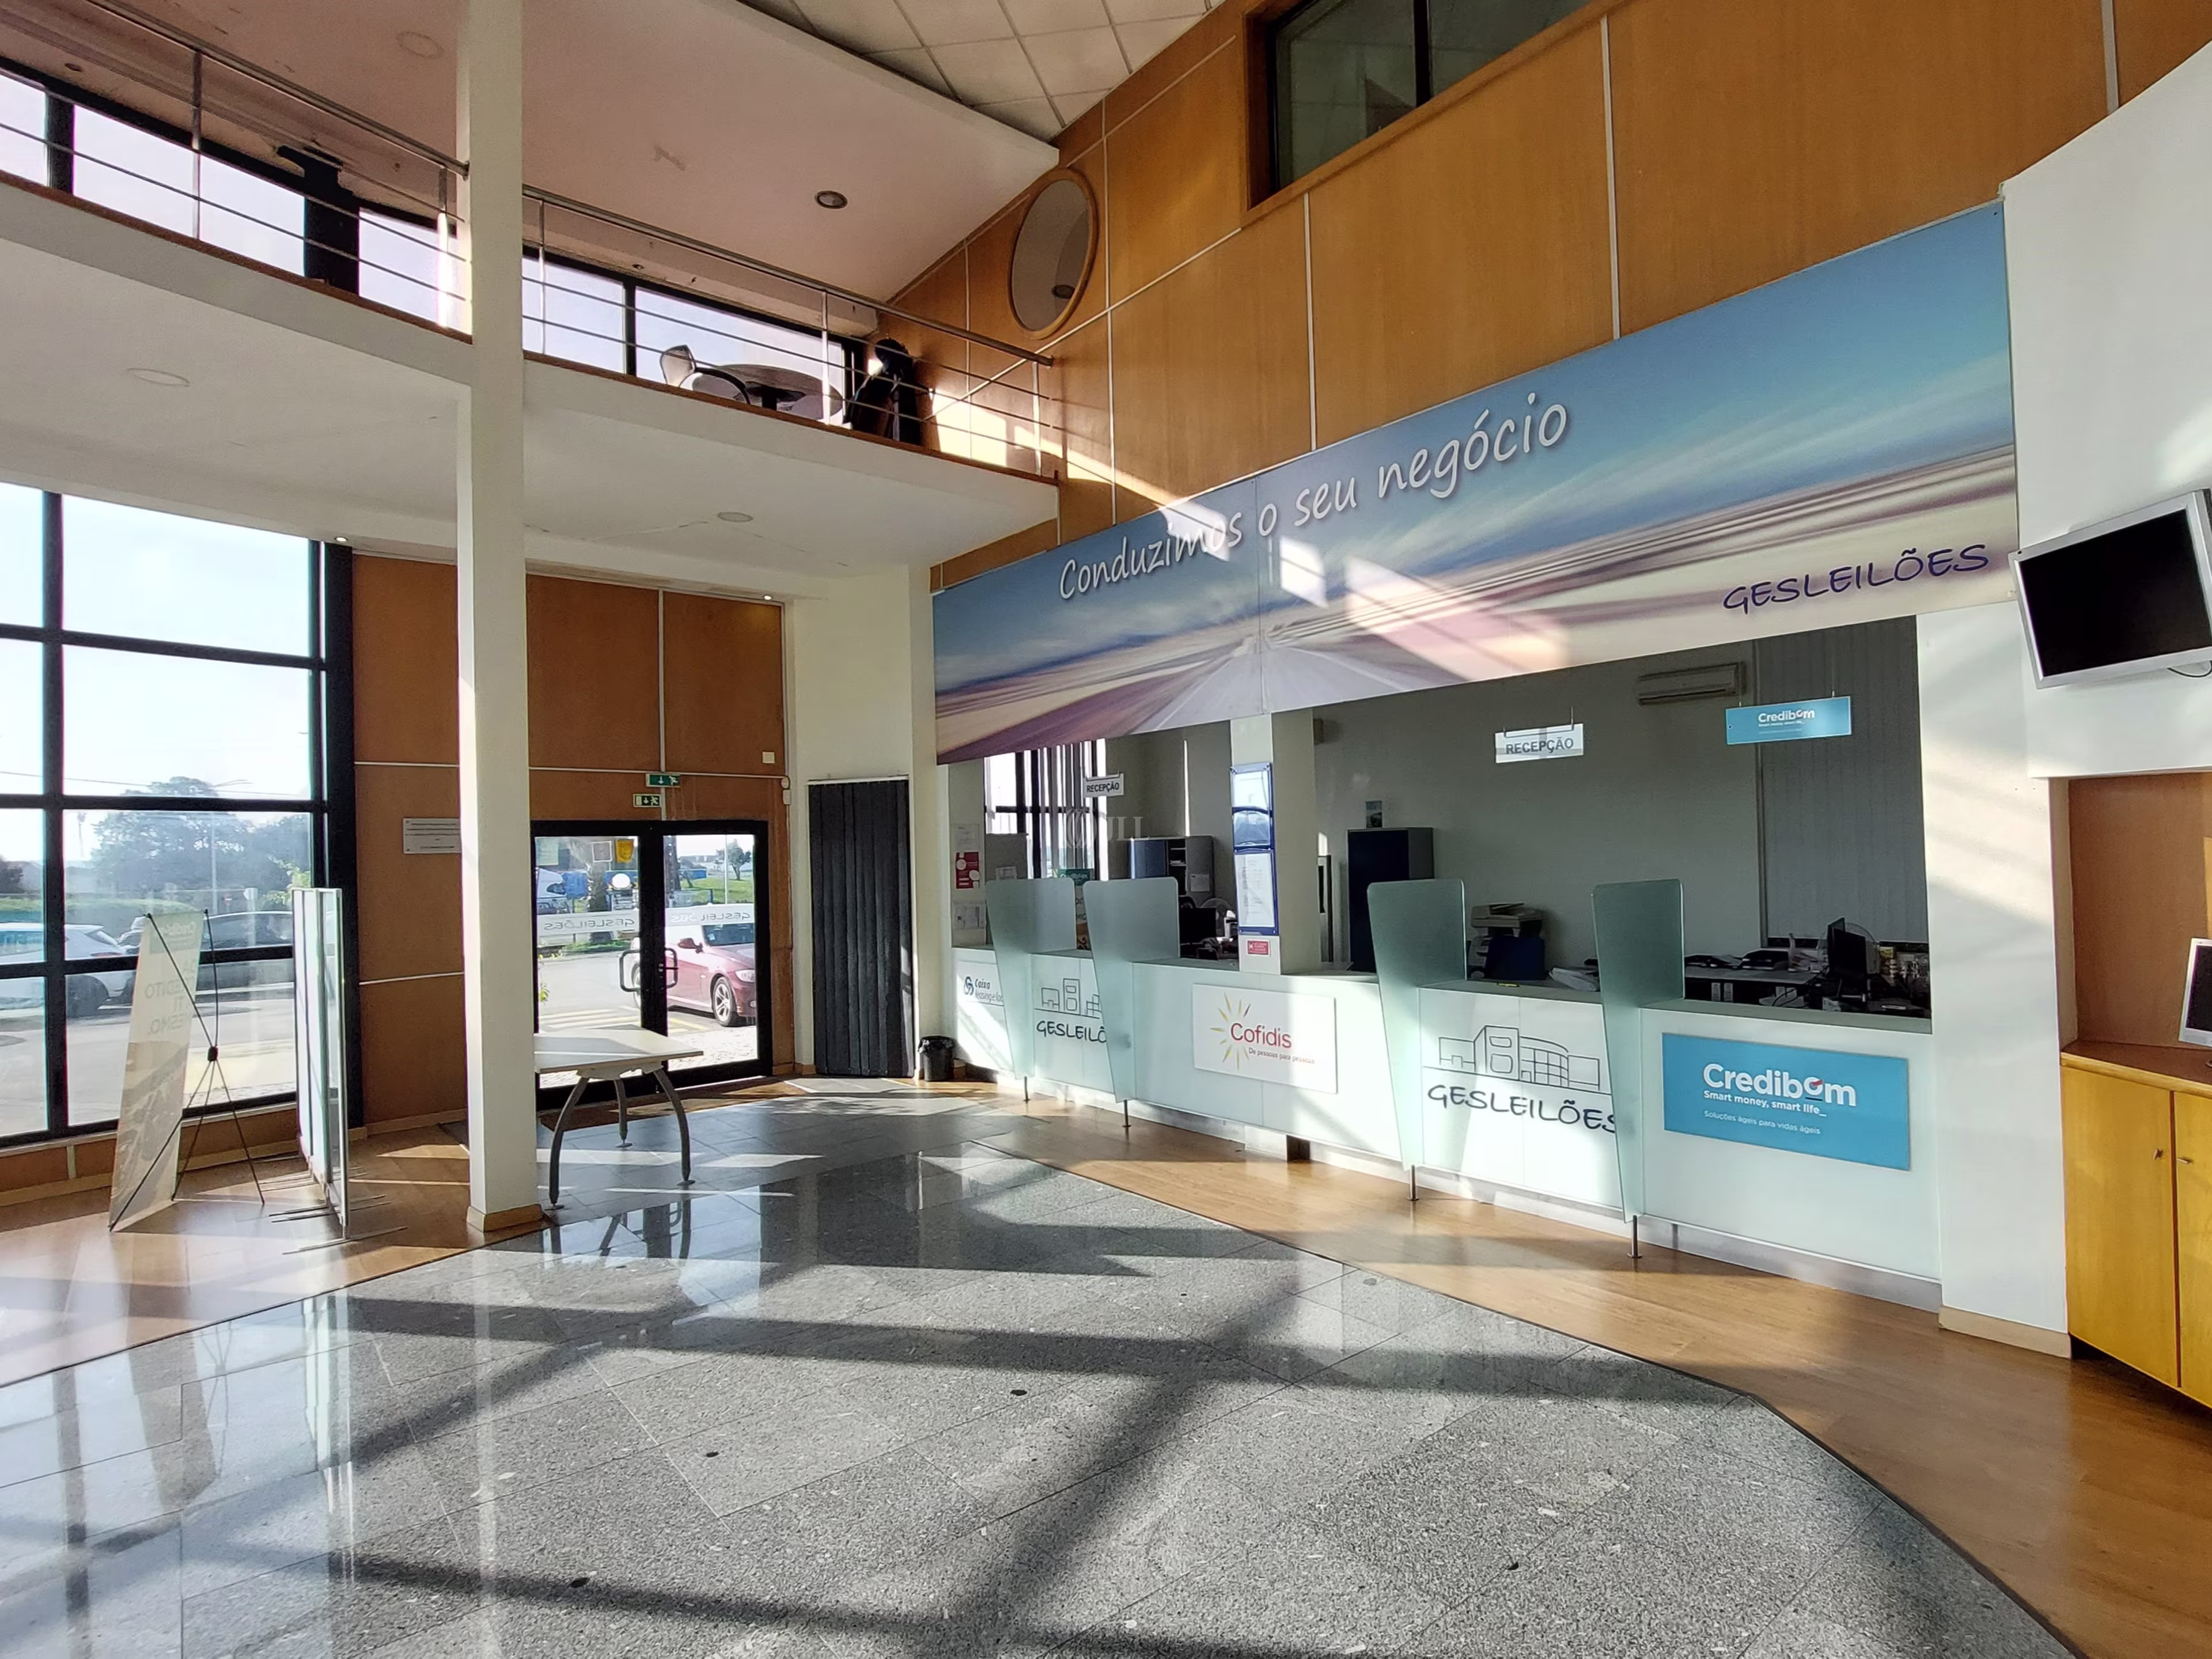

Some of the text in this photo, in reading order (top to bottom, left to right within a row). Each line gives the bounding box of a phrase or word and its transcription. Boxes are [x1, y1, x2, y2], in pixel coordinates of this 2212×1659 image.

[1060, 392, 1567, 600] Conduzimos o seu negócio
[1723, 544, 1989, 615] GESLEILÕES
[1758, 709, 1816, 724] Credibom
[1506, 736, 1574, 754] RECEPÇÃO
[1086, 781, 1120, 793] RECEPÇÃO
[1036, 1020, 1107, 1043] GESLEILÕ
[1230, 1022, 1292, 1048] Cofidis
[1248, 1047, 1256, 1055] De
[1257, 1050, 1278, 1058] pessoas
[1703, 1063, 1857, 1107] Credibom
[1703, 1090, 1732, 1102] Smart
[1734, 1096, 1770, 1109] money,
[1771, 1100, 1801, 1112] smart
[1704, 1110, 1821, 1135] Soluções ágeis para vidas ágeis
